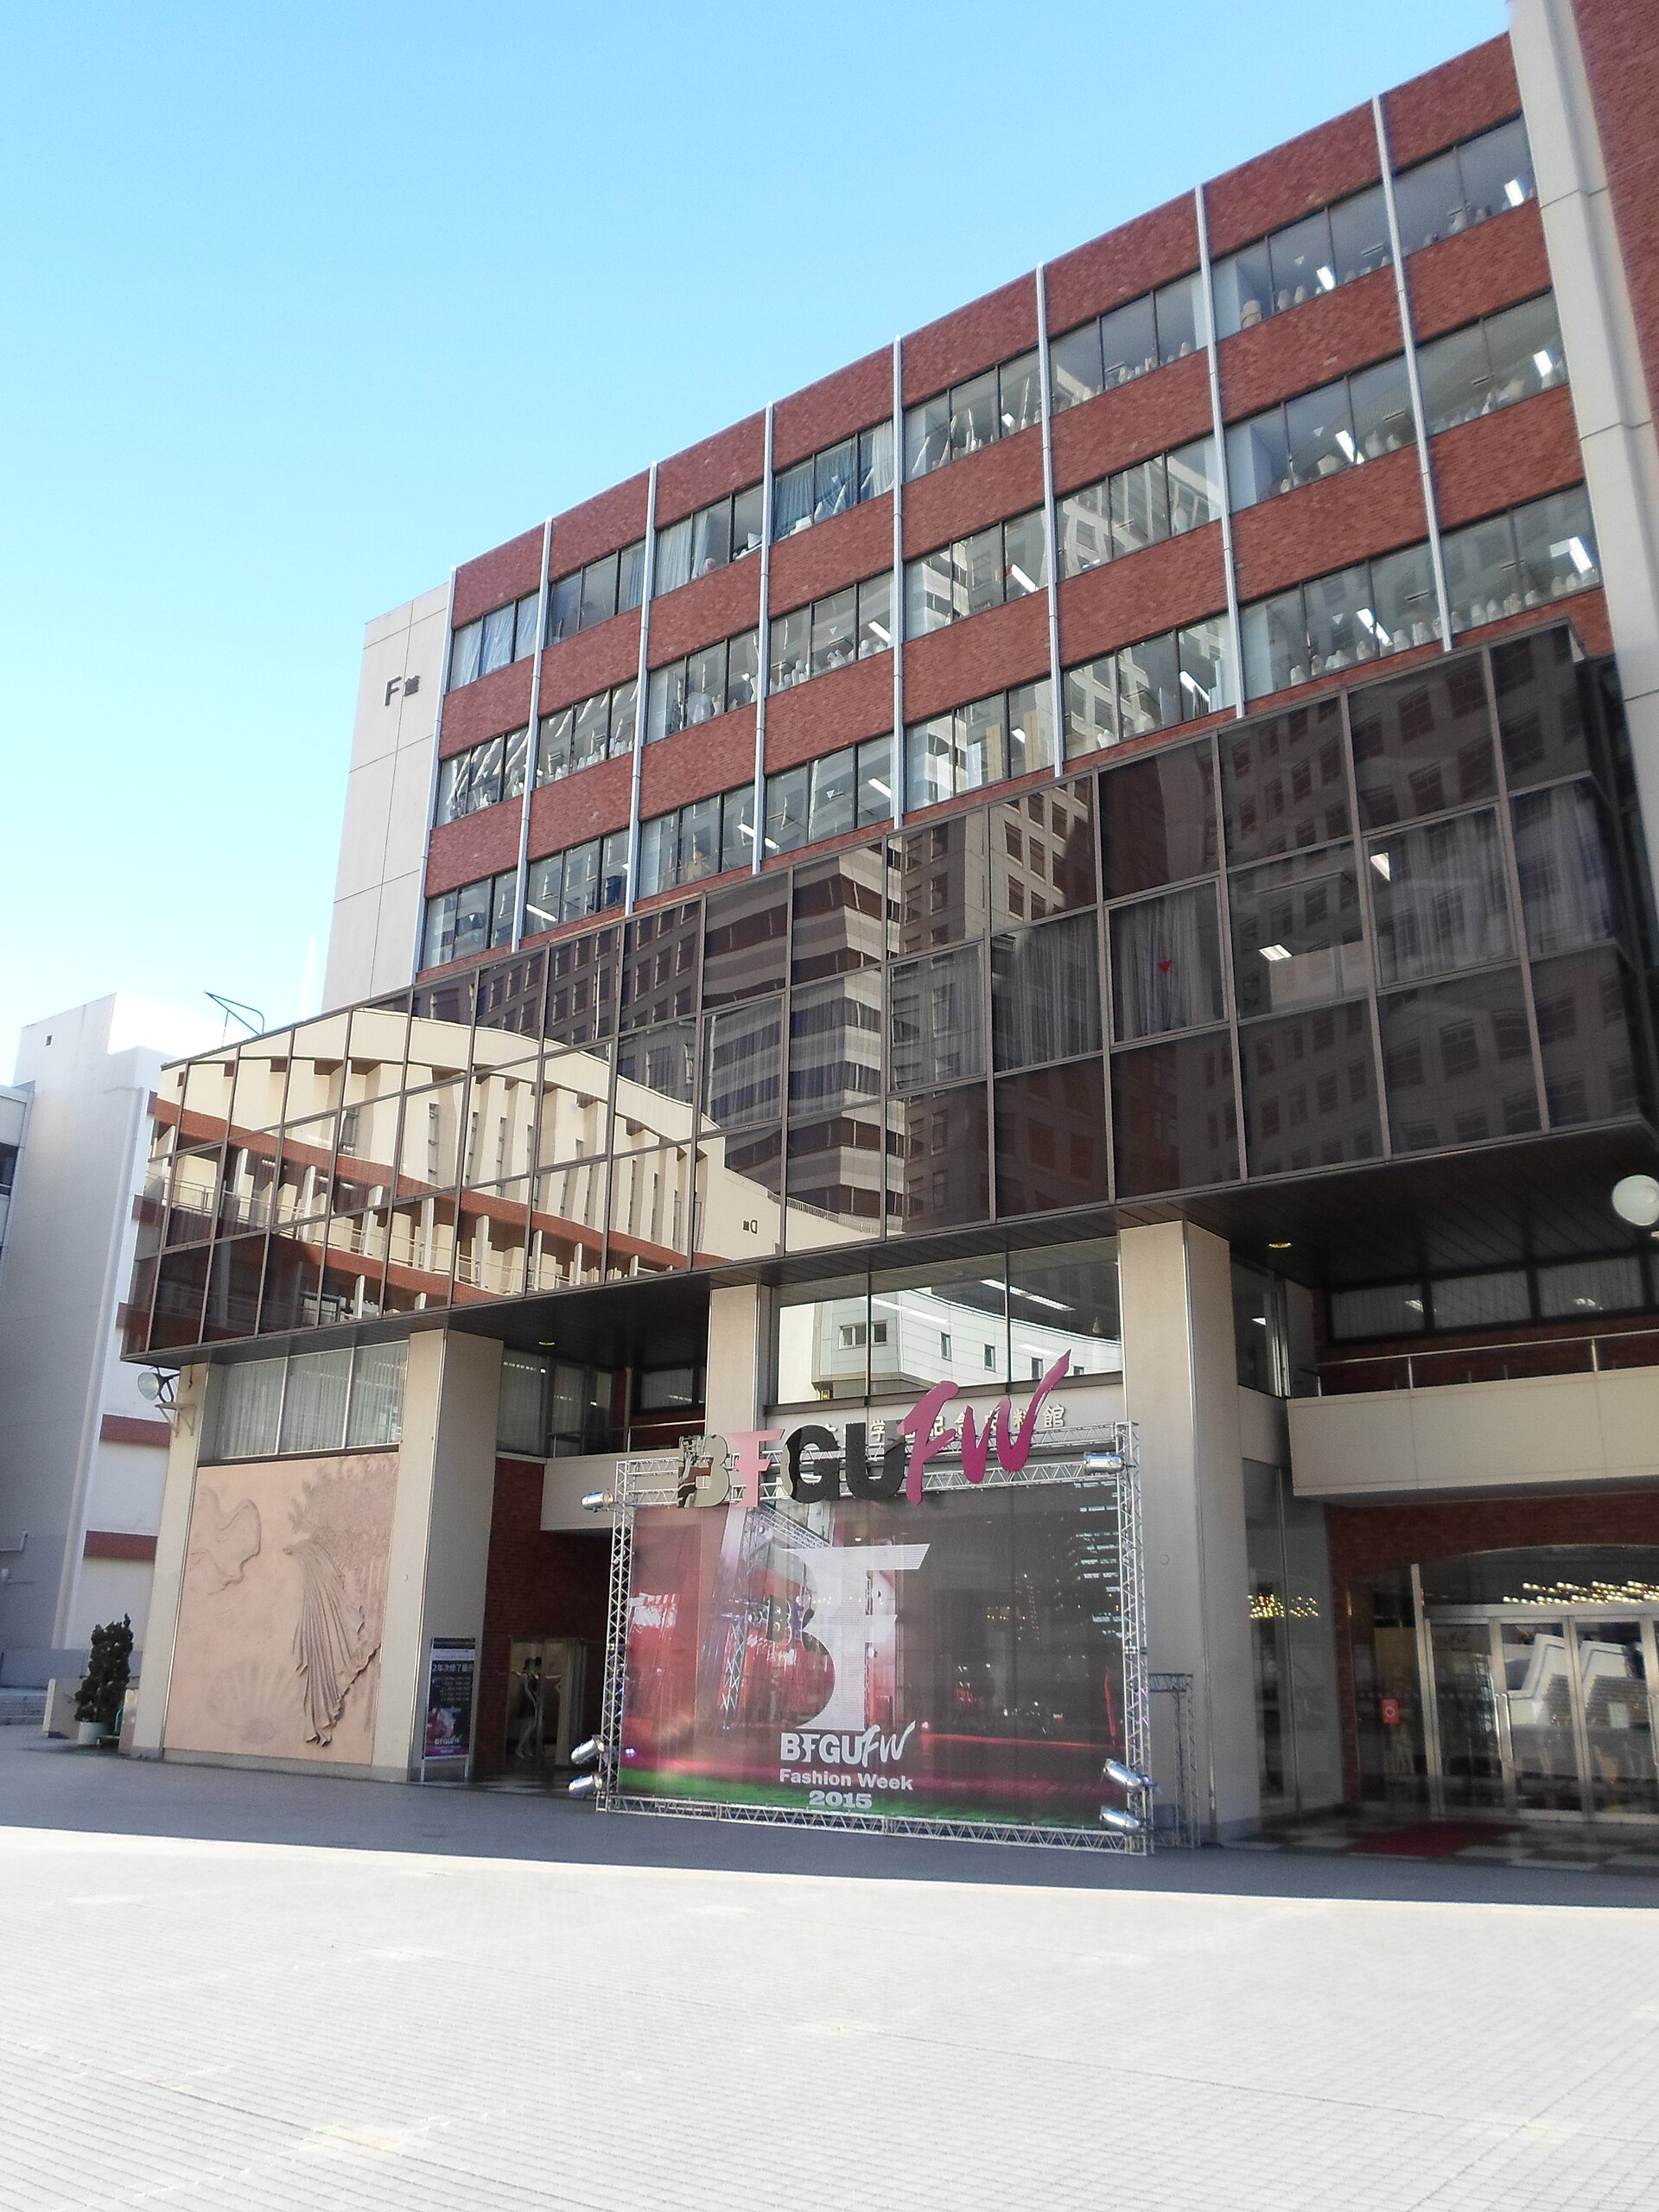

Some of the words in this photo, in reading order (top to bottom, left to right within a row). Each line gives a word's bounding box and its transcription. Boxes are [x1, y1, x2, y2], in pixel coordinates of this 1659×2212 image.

[779, 1768, 852, 1787] Fashion
[857, 1772, 914, 1790] Week
[809, 1789, 874, 1809] 2015
